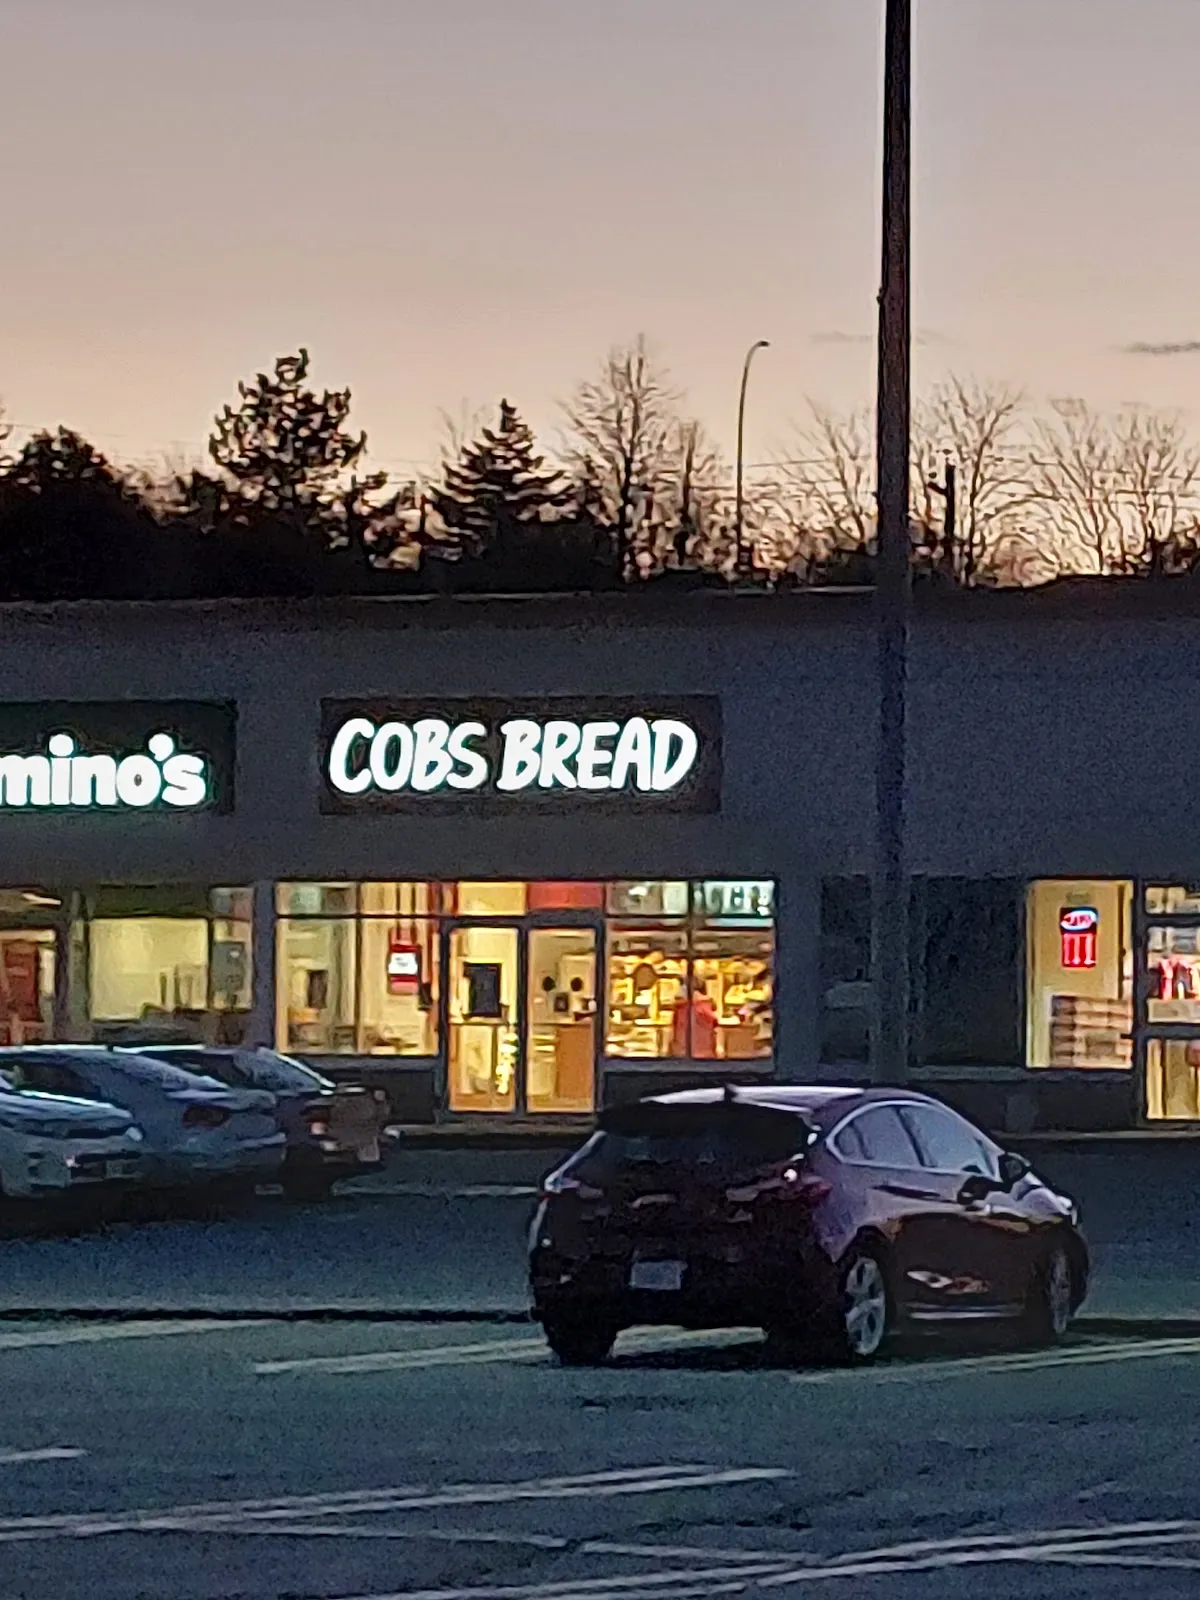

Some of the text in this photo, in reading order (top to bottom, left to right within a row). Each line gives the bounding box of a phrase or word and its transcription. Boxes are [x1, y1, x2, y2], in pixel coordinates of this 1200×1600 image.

[0, 733, 206, 806] mino's
[329, 716, 698, 794] COBS BREAD
